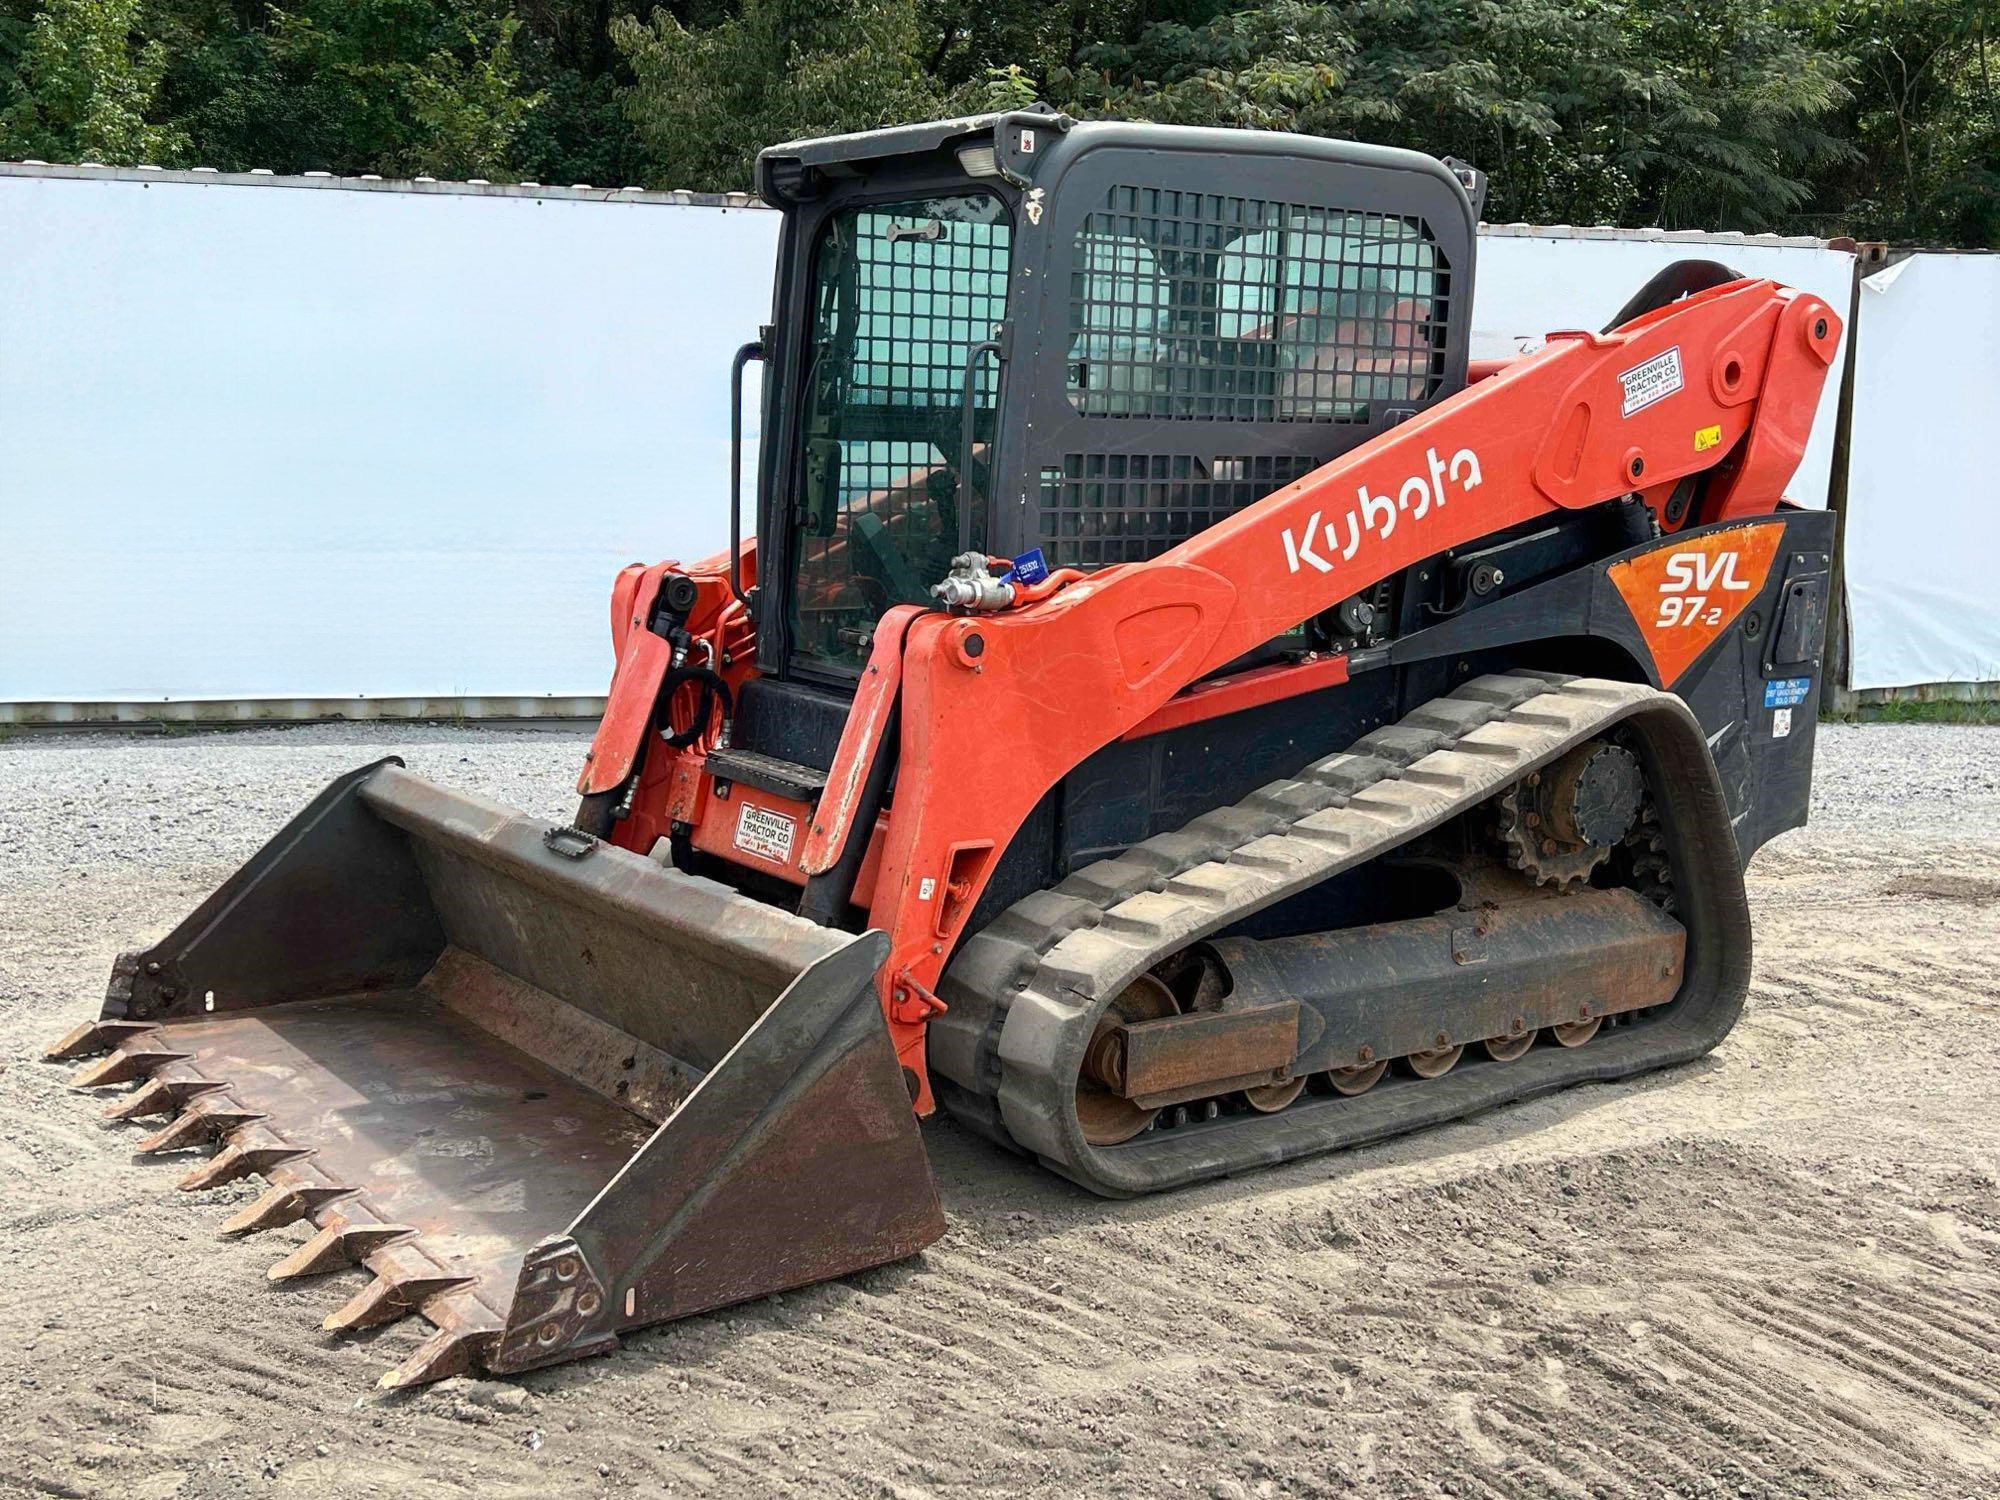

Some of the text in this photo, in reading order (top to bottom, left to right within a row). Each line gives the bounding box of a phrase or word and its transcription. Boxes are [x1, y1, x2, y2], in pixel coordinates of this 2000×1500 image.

[1625, 354, 1674, 385] GREENVILLE
[1625, 364, 1677, 396] TRACTOR CO
[1281, 447, 1482, 574] Kubota
[1658, 551, 1751, 593] SVL
[1655, 596, 1722, 628] 97-2
[743, 820, 789, 844] TRACTOR CO
[745, 810, 790, 832] GREENVILLE
